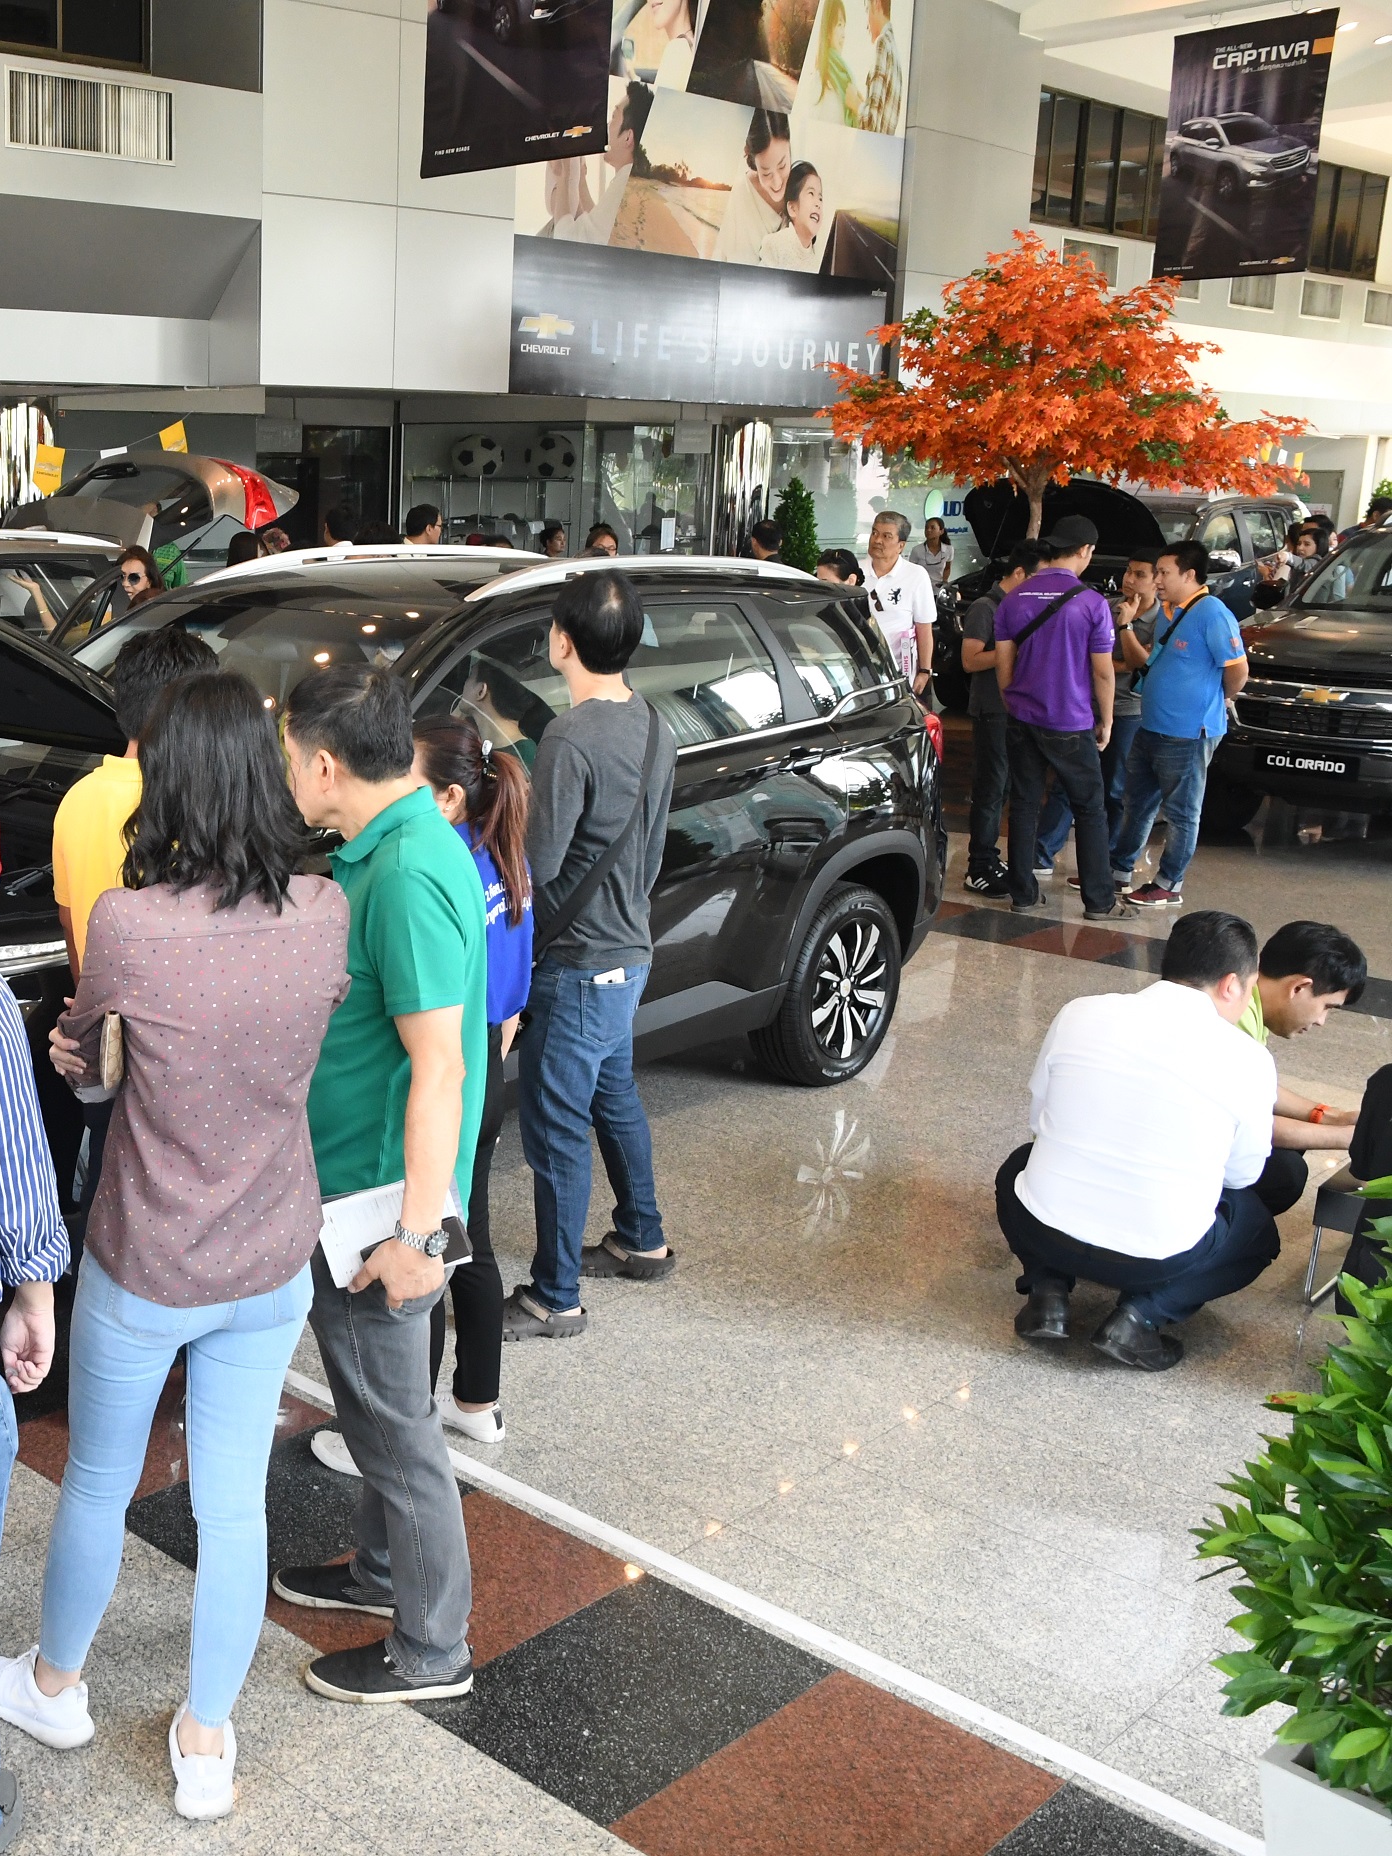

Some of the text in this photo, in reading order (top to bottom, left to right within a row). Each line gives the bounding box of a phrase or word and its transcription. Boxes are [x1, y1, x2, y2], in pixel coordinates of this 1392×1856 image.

[1212, 40, 1310, 70] CAPTIVA
[524, 131, 560, 143] CHEVROLET
[456, 145, 470, 154] ROADS
[520, 343, 571, 356] CHEVROLET
[731, 335, 881, 375] JOURNEY
[1266, 754, 1346, 774] COLORADO
